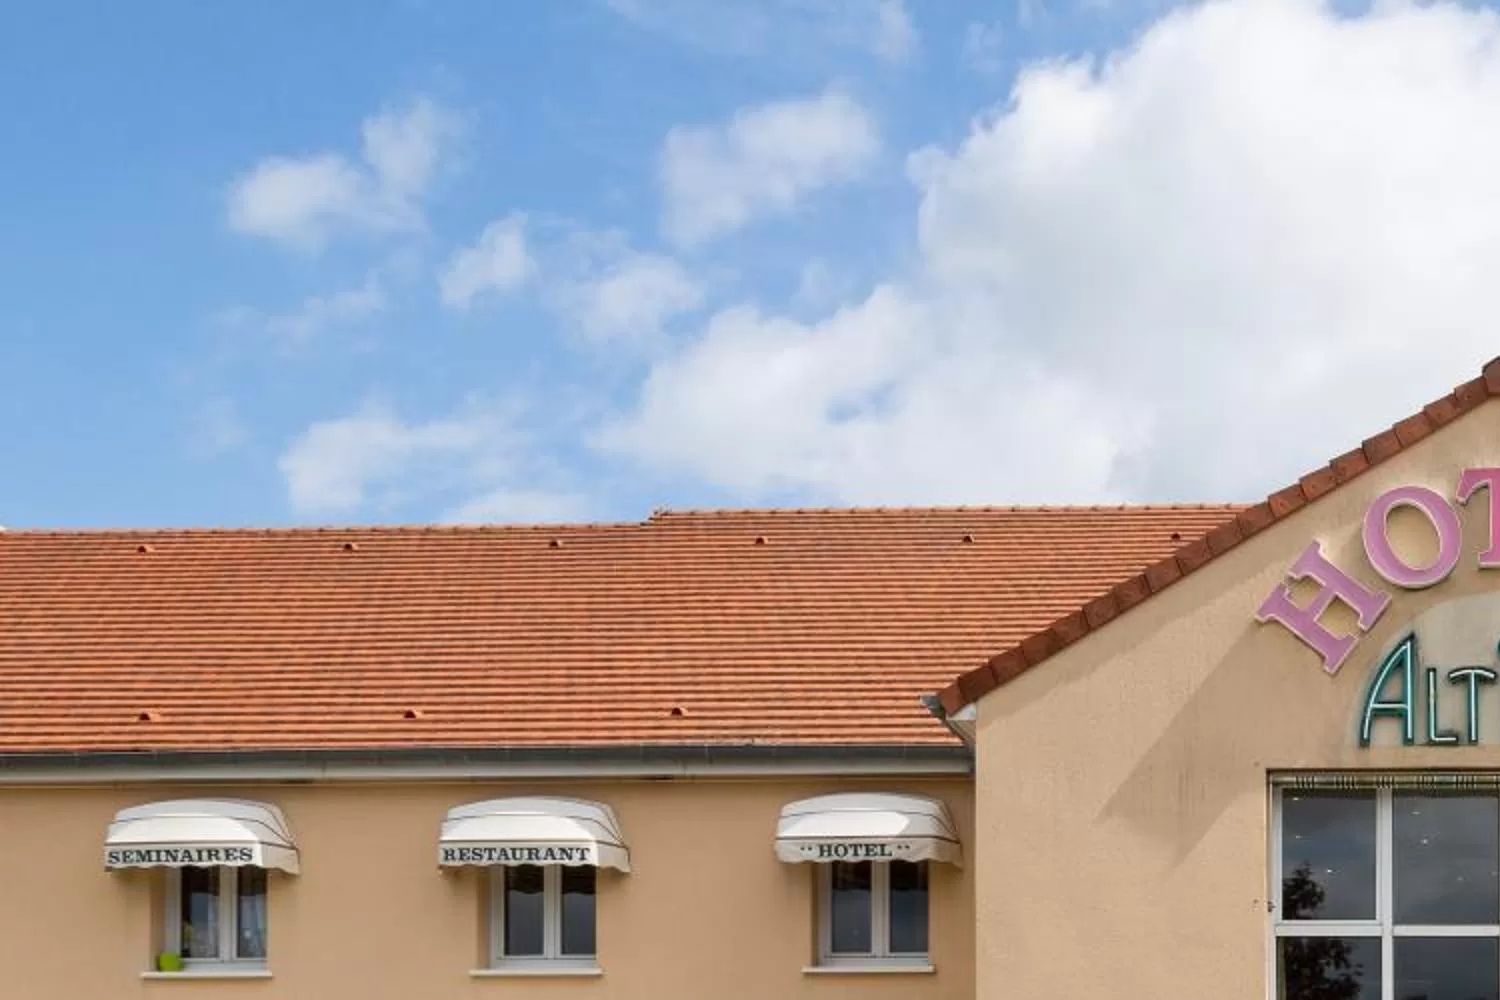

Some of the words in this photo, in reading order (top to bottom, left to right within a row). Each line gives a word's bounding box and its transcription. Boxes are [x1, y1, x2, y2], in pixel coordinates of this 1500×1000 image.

[107, 847, 253, 865] SEMINAIRES
[443, 847, 591, 862] RESTAURANT
[818, 843, 893, 858] HOTEL
